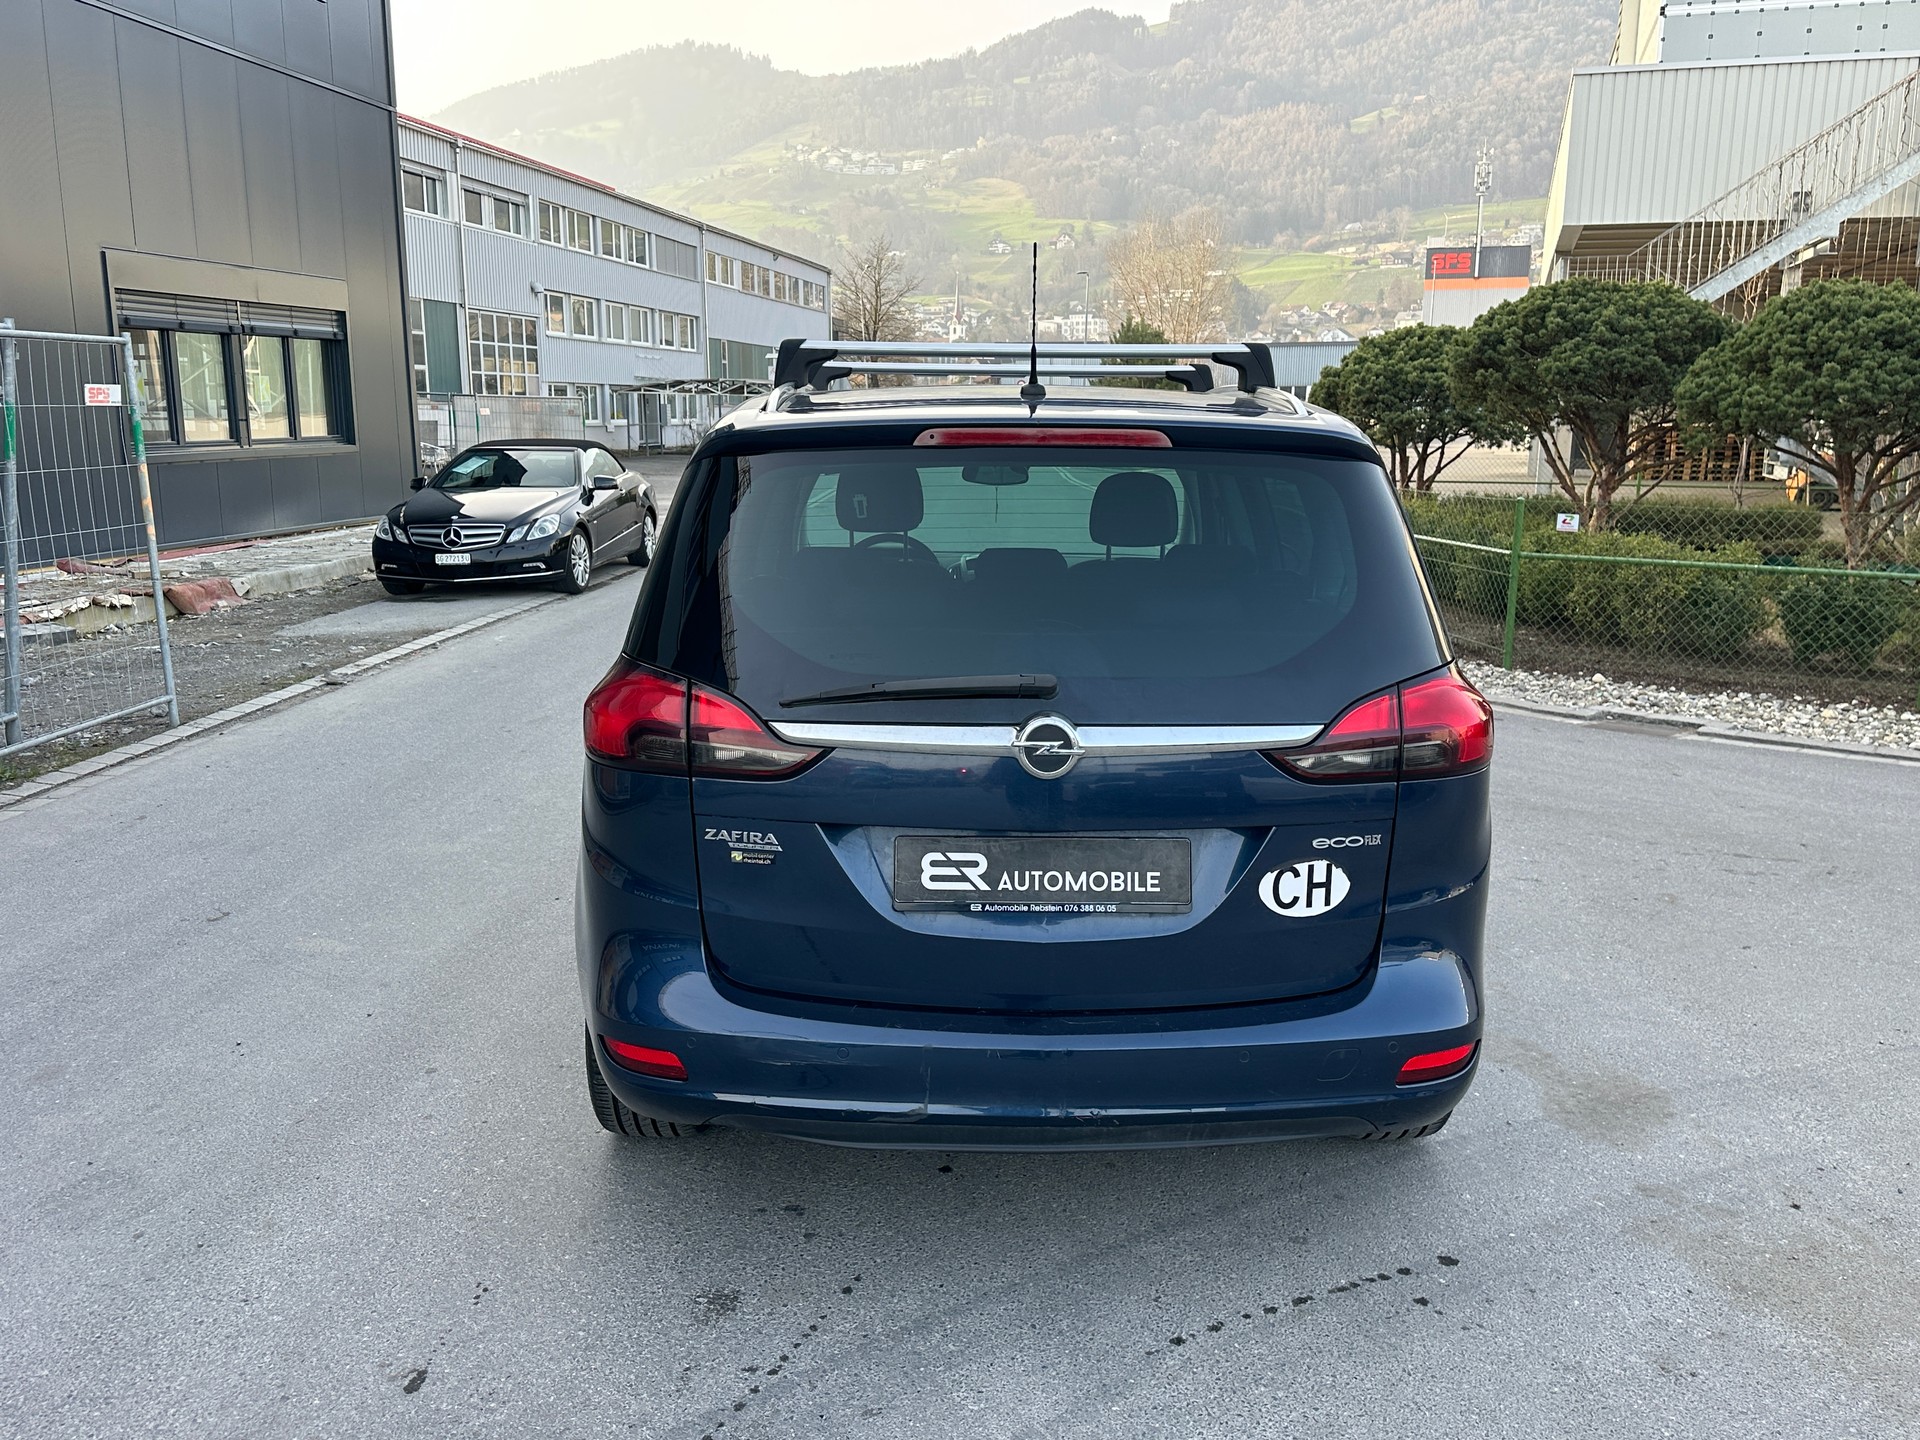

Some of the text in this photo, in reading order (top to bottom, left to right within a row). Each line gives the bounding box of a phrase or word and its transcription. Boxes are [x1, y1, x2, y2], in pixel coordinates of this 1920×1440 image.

[1431, 252, 1472, 269] SFS
[88, 387, 110, 399] SFS
[704, 828, 779, 845] ZAFIRA
[997, 871, 1161, 892] AUTOMOBILE
[1273, 863, 1333, 910] CH
[984, 904, 1028, 912] Automobile
[1030, 904, 1062, 912] Rebstein
